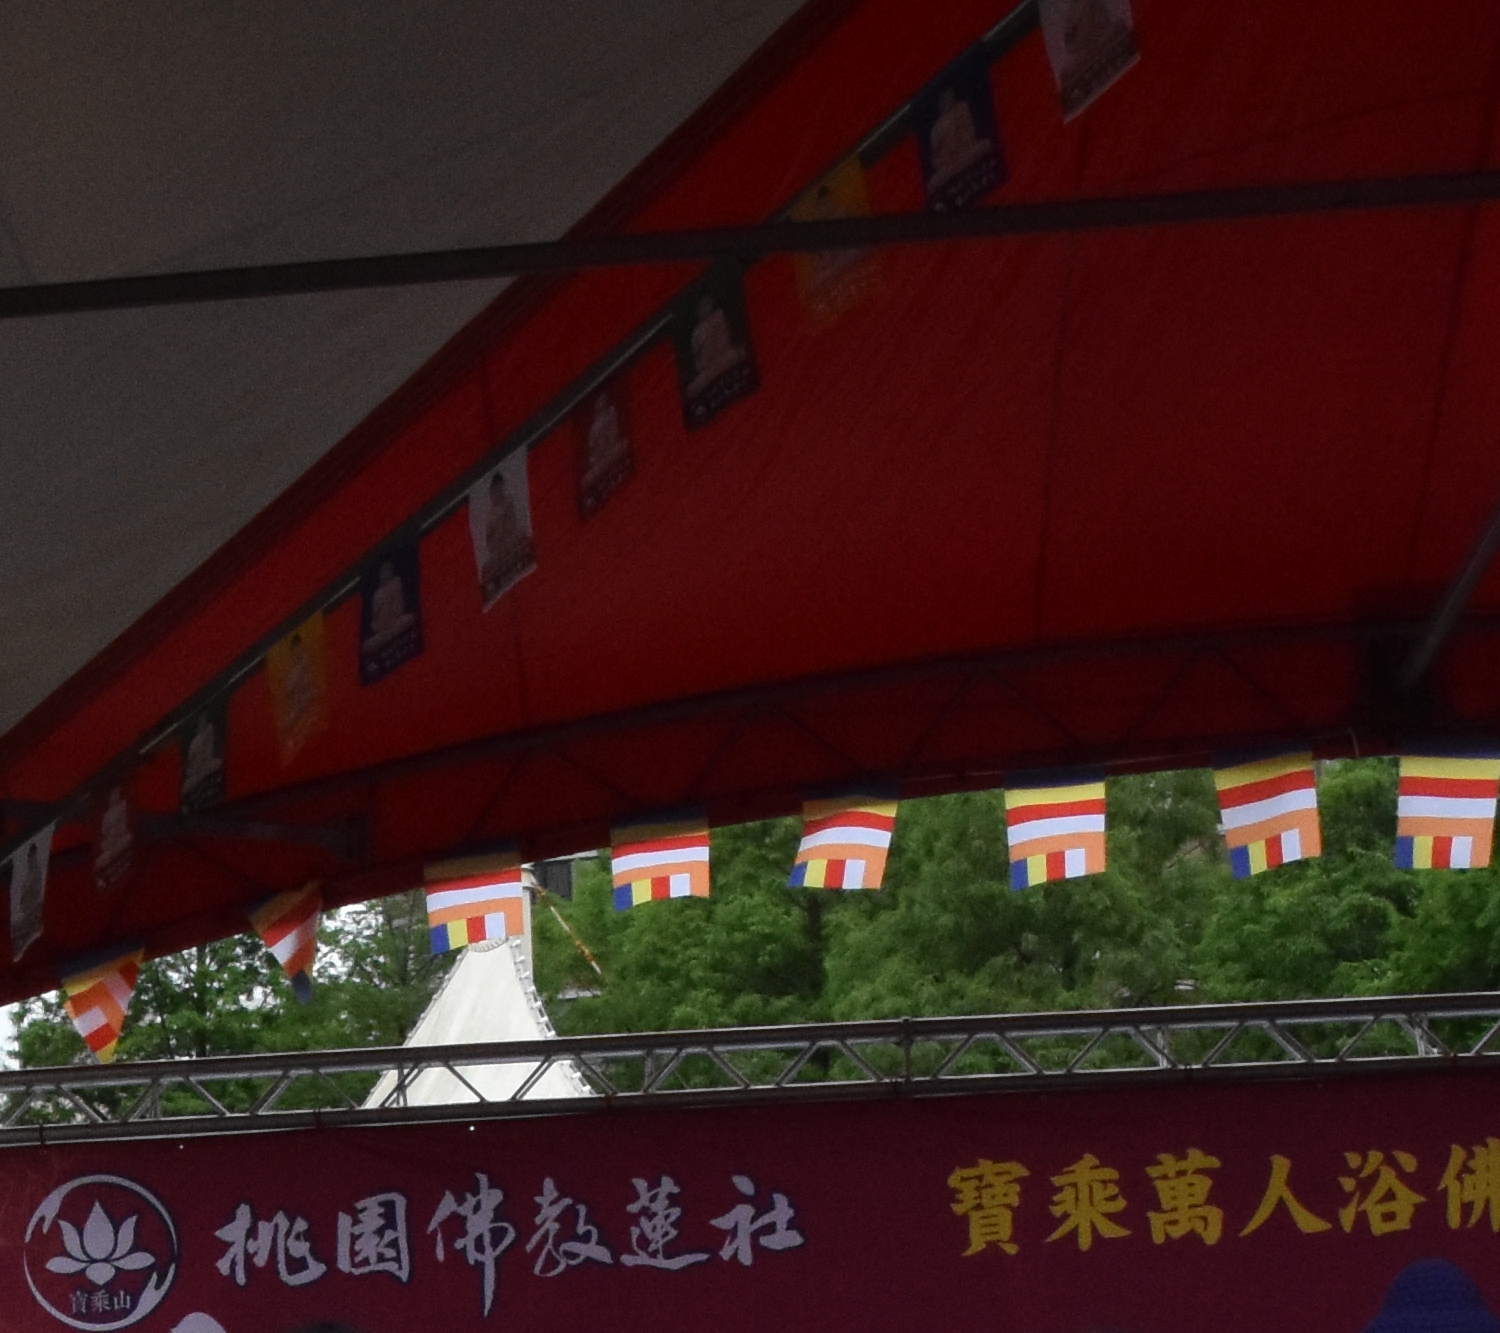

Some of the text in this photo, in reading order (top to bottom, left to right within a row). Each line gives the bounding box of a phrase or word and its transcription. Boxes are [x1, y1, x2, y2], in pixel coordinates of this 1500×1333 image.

[215, 1172, 804, 1318] 桃園佛教蓮社
